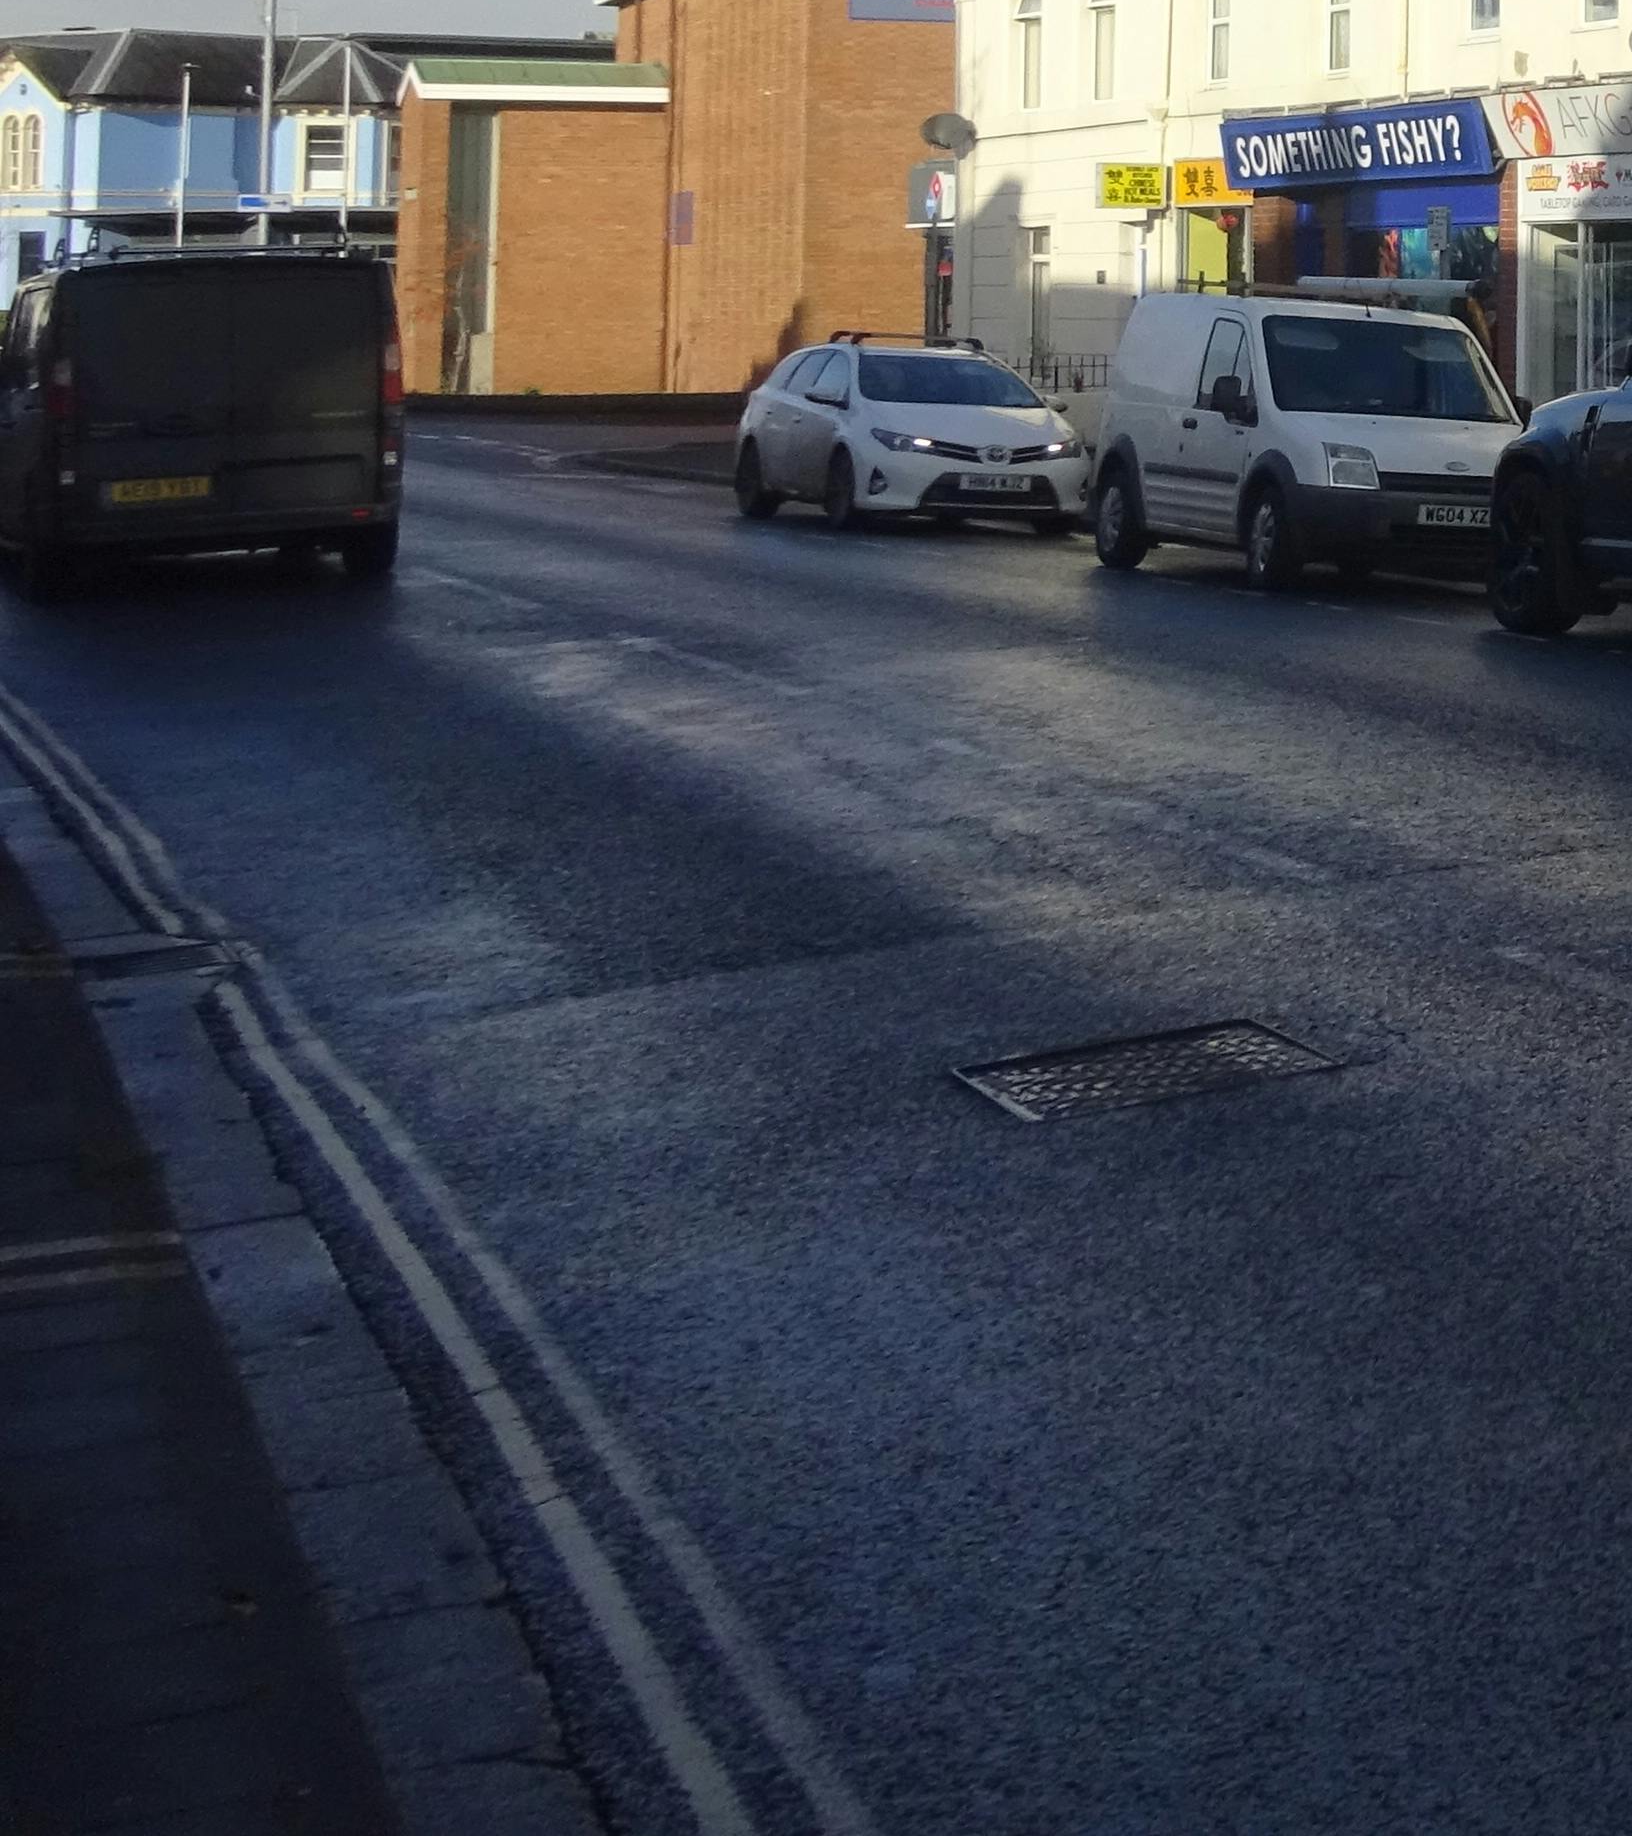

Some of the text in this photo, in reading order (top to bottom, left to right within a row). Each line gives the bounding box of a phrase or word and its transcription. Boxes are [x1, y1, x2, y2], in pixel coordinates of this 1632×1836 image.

[1236, 114, 1462, 178] SOMETHING FISHY?
[1426, 506, 1489, 525] WG04 XZ
